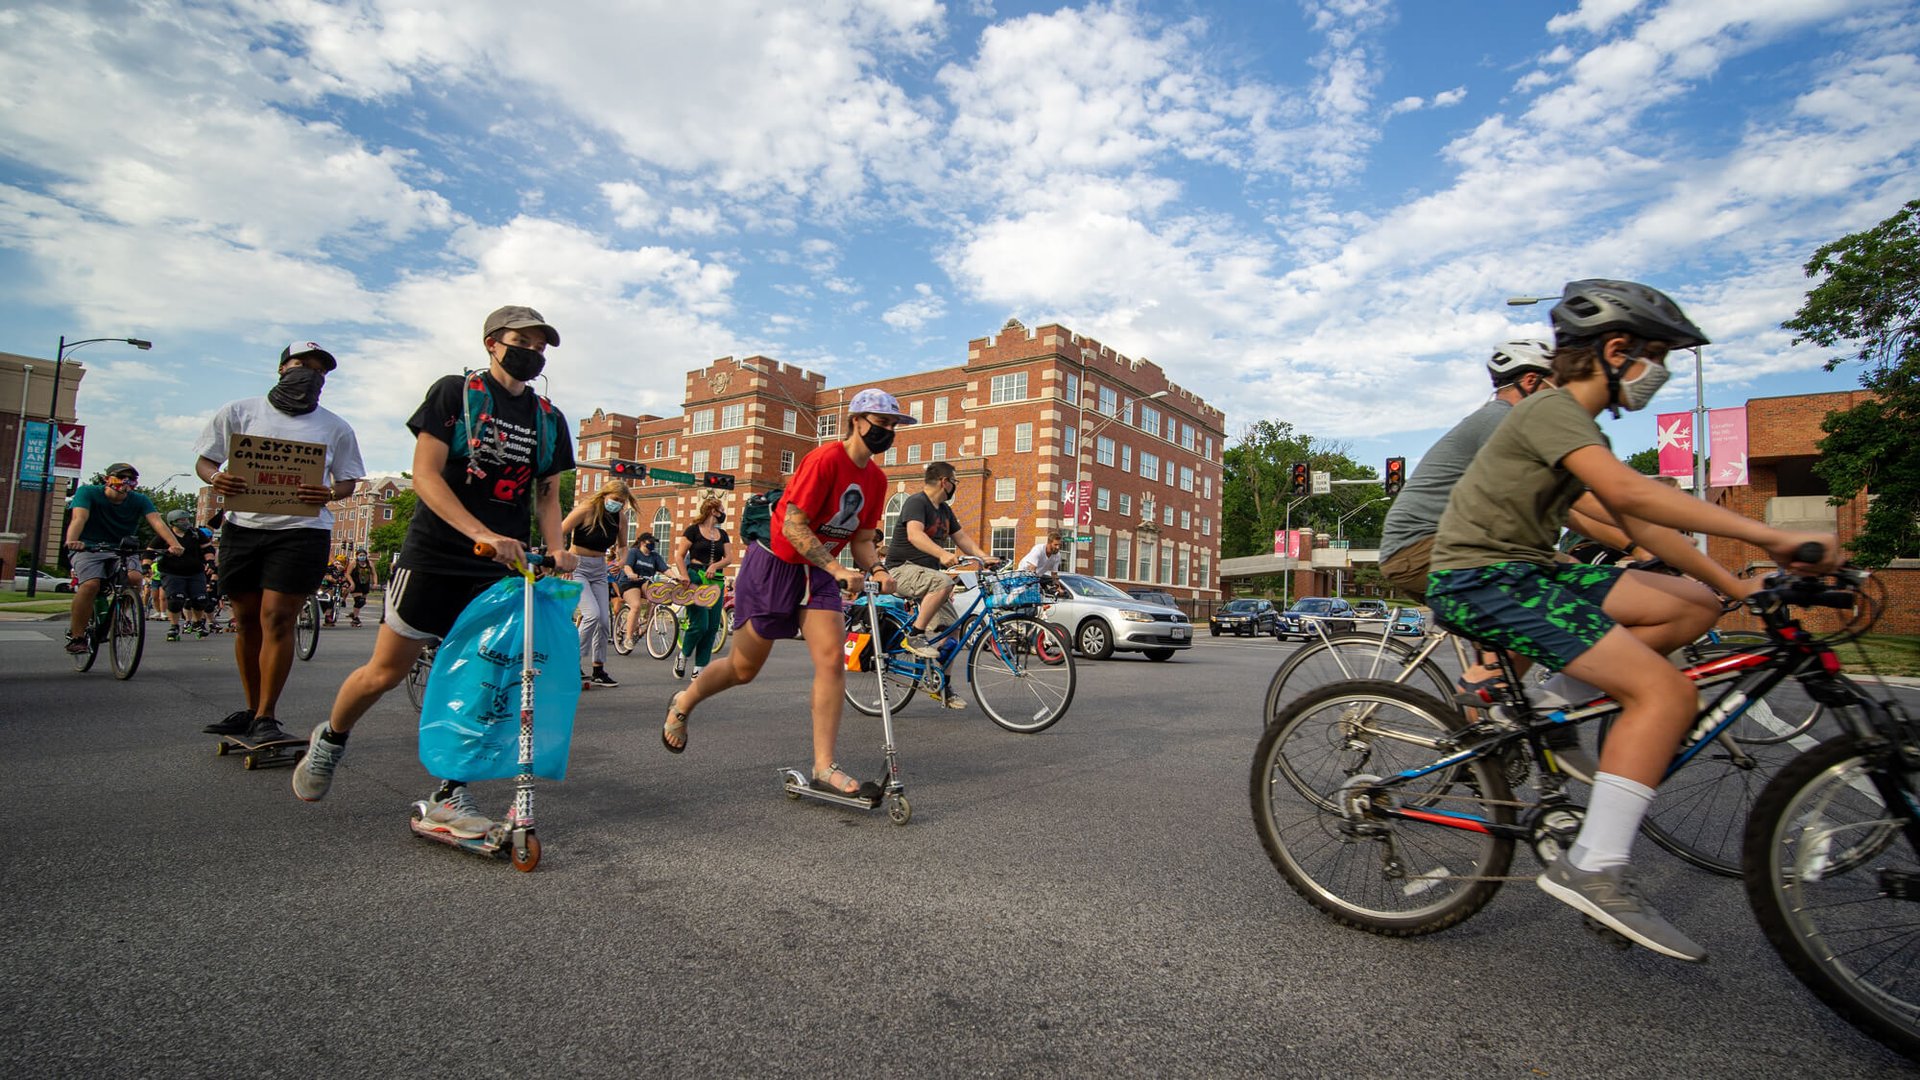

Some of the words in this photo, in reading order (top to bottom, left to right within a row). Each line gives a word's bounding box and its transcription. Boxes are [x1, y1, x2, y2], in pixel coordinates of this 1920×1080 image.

[514, 424, 531, 434] flag
[240, 438, 252, 447] A
[260, 440, 323, 456] SYSTEM
[506, 441, 532, 454] killing
[257, 472, 302, 486] NEVER
[243, 488, 285, 496] ESIGNED
